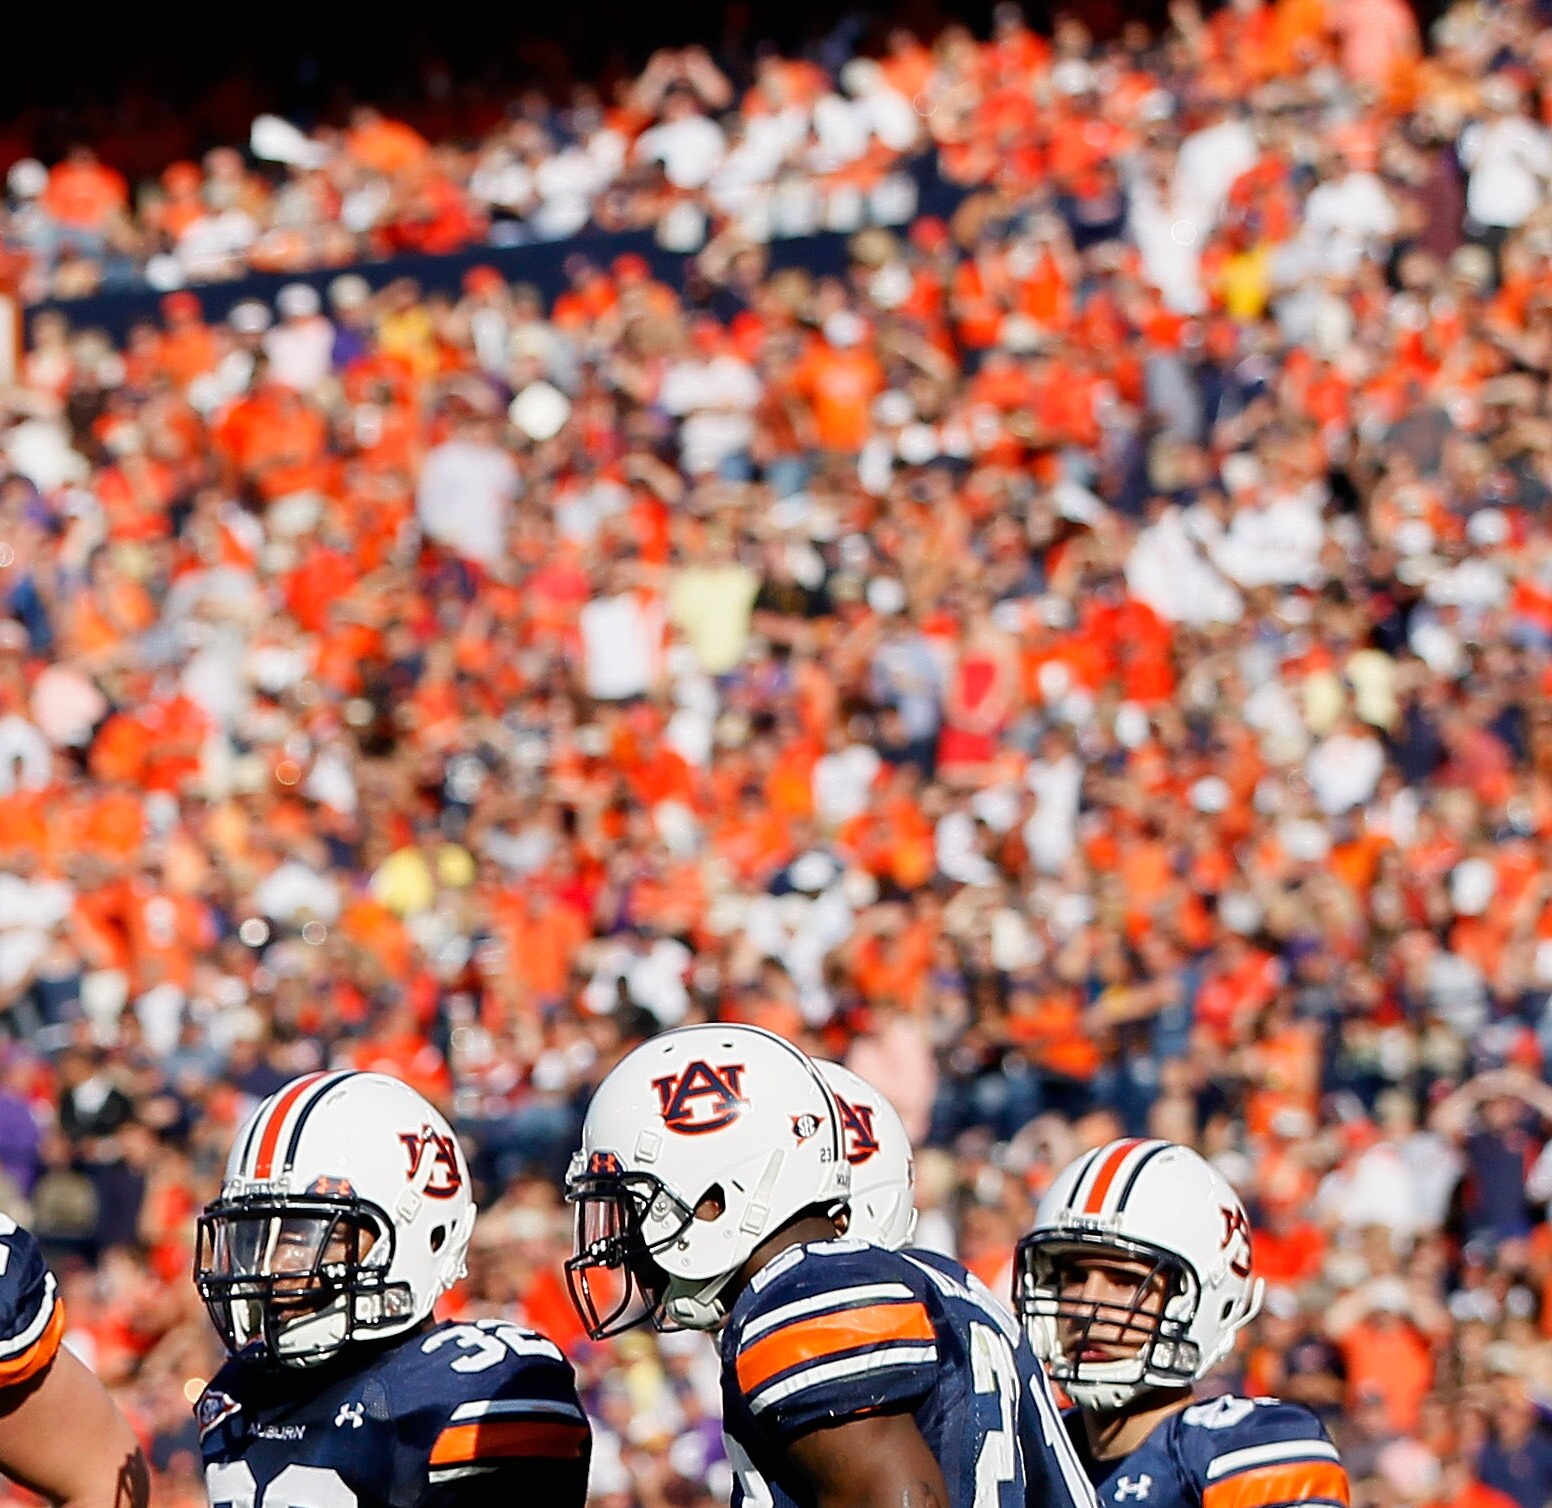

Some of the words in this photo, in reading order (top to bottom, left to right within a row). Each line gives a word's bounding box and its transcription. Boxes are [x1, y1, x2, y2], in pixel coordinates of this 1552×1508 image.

[819, 1146, 833, 1163] 23
[421, 1319, 564, 1373] 32
[247, 1421, 306, 1441] AUBURN
